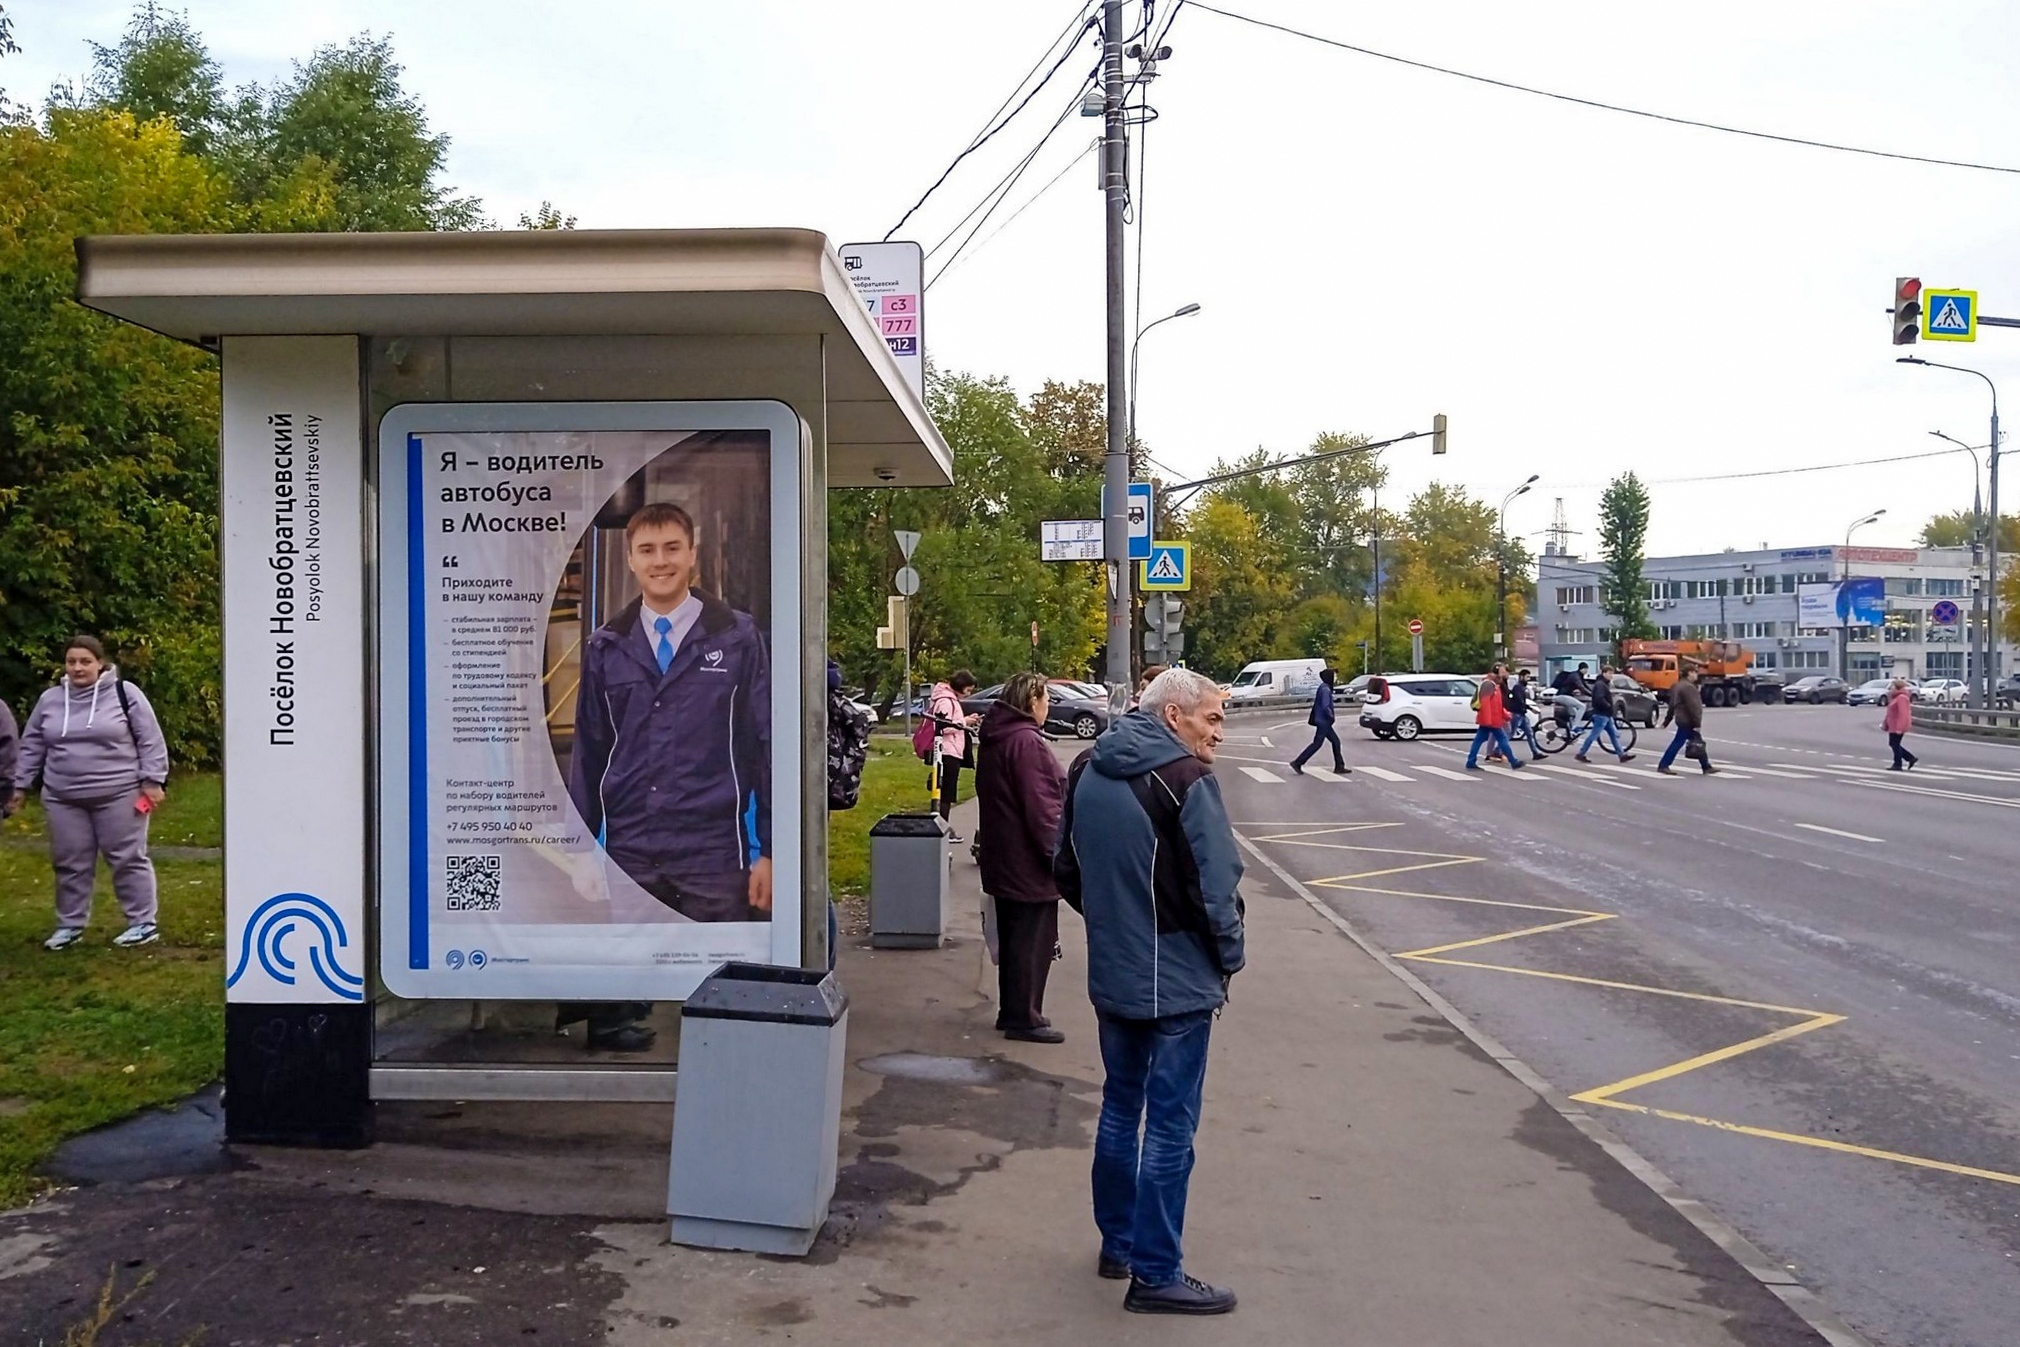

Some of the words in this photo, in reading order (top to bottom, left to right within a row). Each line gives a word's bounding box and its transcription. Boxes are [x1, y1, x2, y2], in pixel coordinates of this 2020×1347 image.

[867, 300, 875, 312] 7
[886, 320, 912, 332] 777
[440, 451, 457, 471] Я
[488, 455, 604, 474] водитель
[304, 414, 322, 549] Novobrattsevskiy
[440, 481, 552, 506] автобуса
[268, 412, 300, 634] Новобратцевский
[442, 518, 455, 533] в
[461, 512, 566, 533] Москве!
[305, 553, 324, 622] Posyolok
[442, 577, 513, 590] Приходите
[442, 593, 449, 602] в
[453, 593, 485, 604] нашу
[488, 592, 544, 604] команду
[451, 615, 495, 623] стабильная
[452, 638, 495, 646] бесплатное
[462, 649, 507, 657] стипендией
[452, 662, 501, 670] оформление
[463, 673, 504, 681] трудовому
[506, 672, 537, 680] кодексу
[270, 641, 294, 745] Посёлок
[481, 704, 527, 712] бесплатный
[491, 735, 520, 744] бонусы
[446, 779, 515, 789] Контакт-центр
[460, 791, 493, 801] набору
[496, 791, 545, 800] водителей
[446, 805, 501, 813] регулярных
[504, 804, 558, 813] маршрутов
[447, 822, 458, 831] +7
[460, 822, 479, 831] 495
[481, 822, 501, 831] 950
[503, 822, 517, 831] 40
[519, 822, 533, 831] 40
[446, 835, 581, 846] www.mosgortrans.ru/career/
